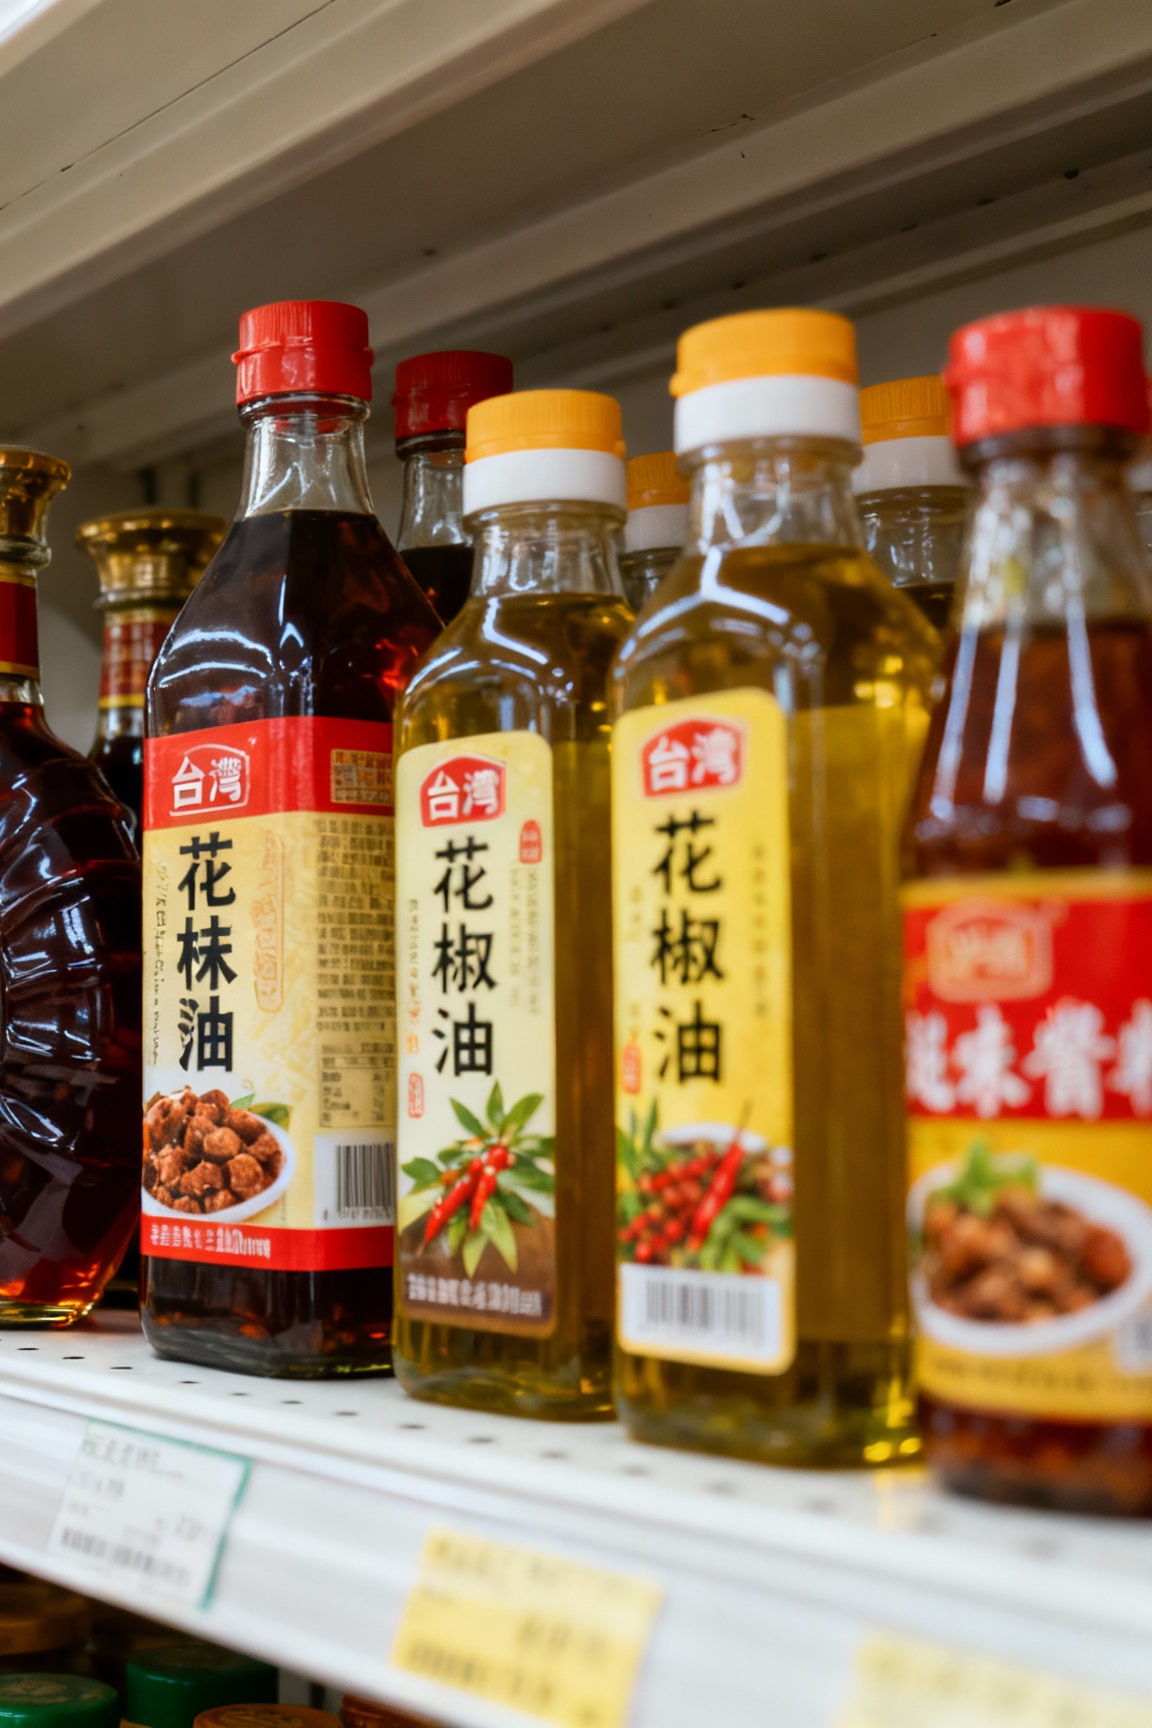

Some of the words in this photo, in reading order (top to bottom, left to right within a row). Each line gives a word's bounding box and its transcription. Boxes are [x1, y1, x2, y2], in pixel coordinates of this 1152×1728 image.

[172, 755, 242, 809] 台灣
[649, 727, 738, 792] 台灣
[427, 769, 501, 821] 台灣
[431, 836, 498, 1077] 花椒油
[651, 810, 724, 1085] 花椒油
